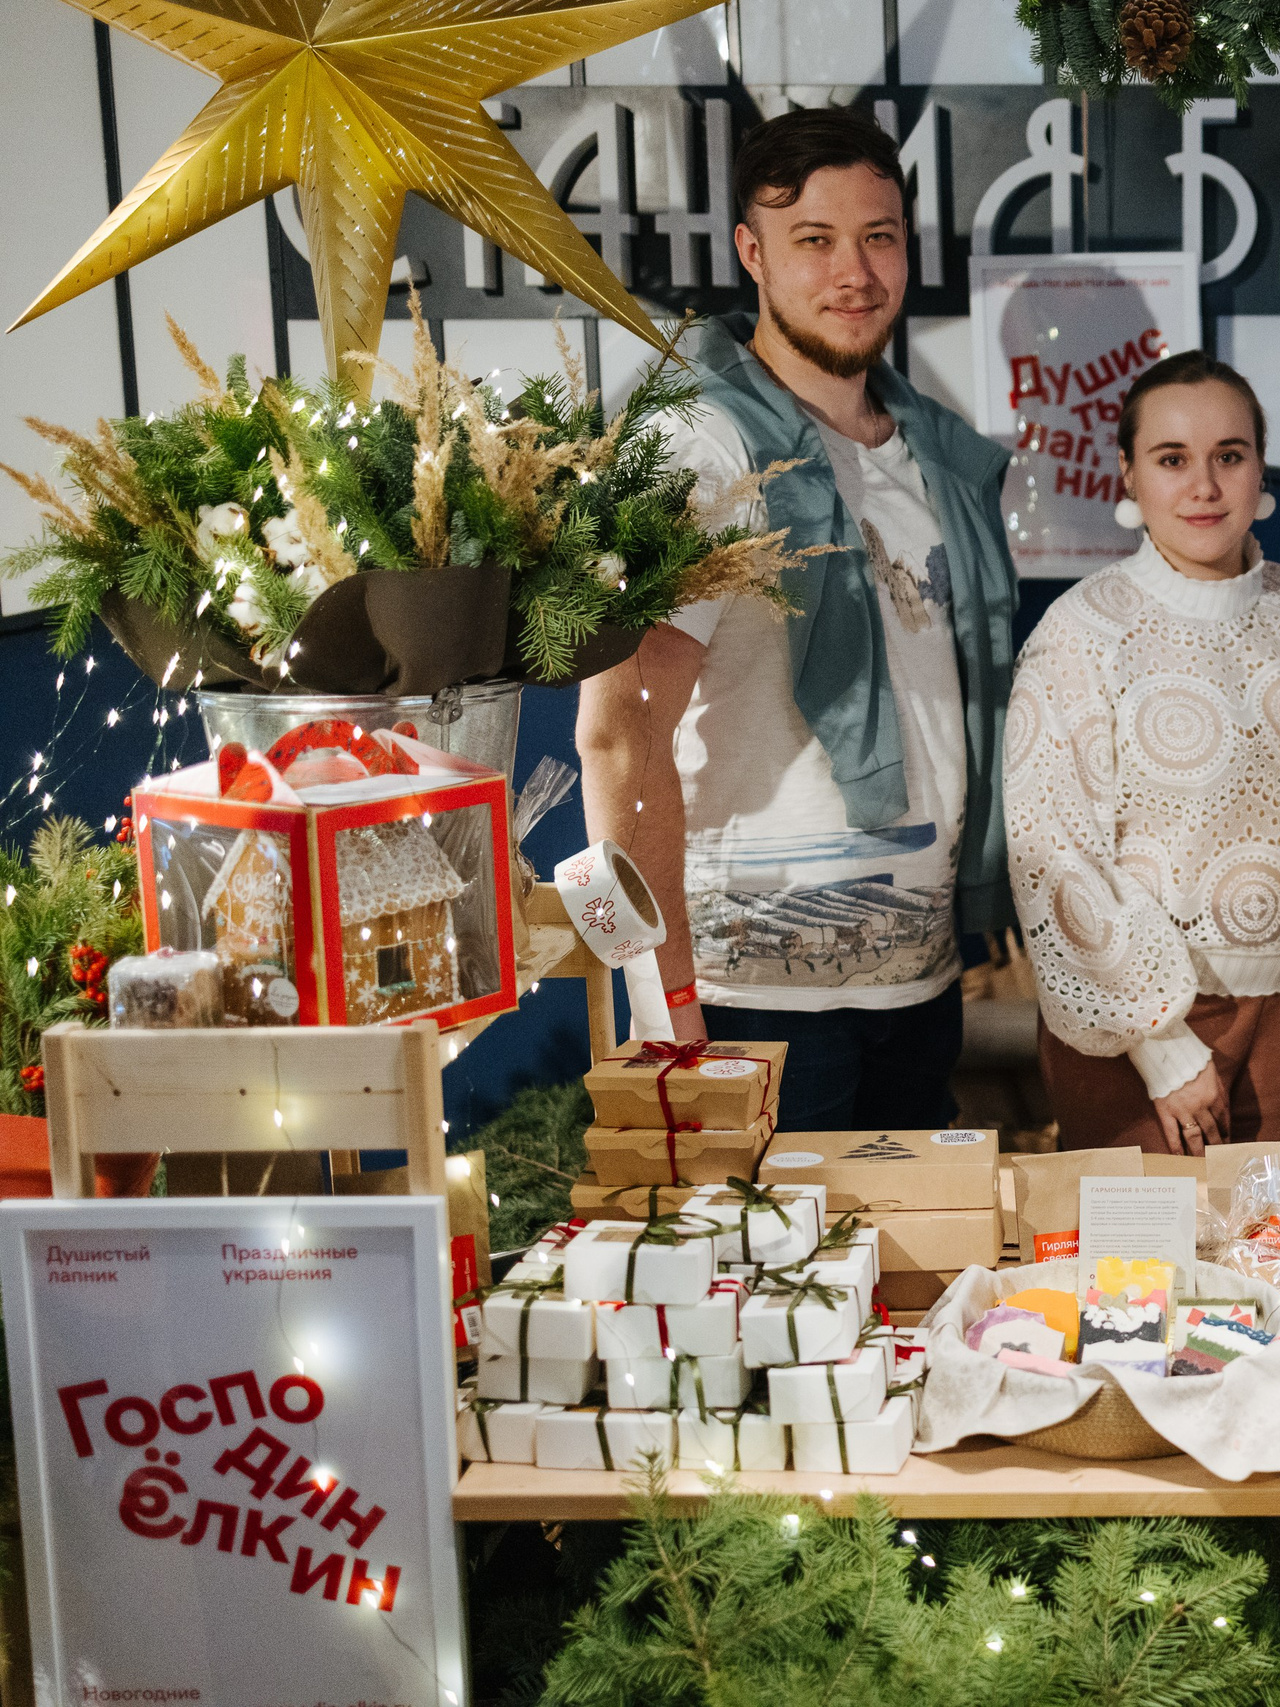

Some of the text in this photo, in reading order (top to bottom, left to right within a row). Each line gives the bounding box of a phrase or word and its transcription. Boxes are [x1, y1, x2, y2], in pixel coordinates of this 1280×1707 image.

[47, 1246, 150, 1264] Душистый
[221, 1244, 358, 1262] Праздничные
[49, 1269, 118, 1283] лапник
[222, 1266, 332, 1284] украшения
[57, 1370, 325, 1458] Госпо
[213, 1427, 387, 1550] дин
[82, 1686, 201, 1701] Новогодние
